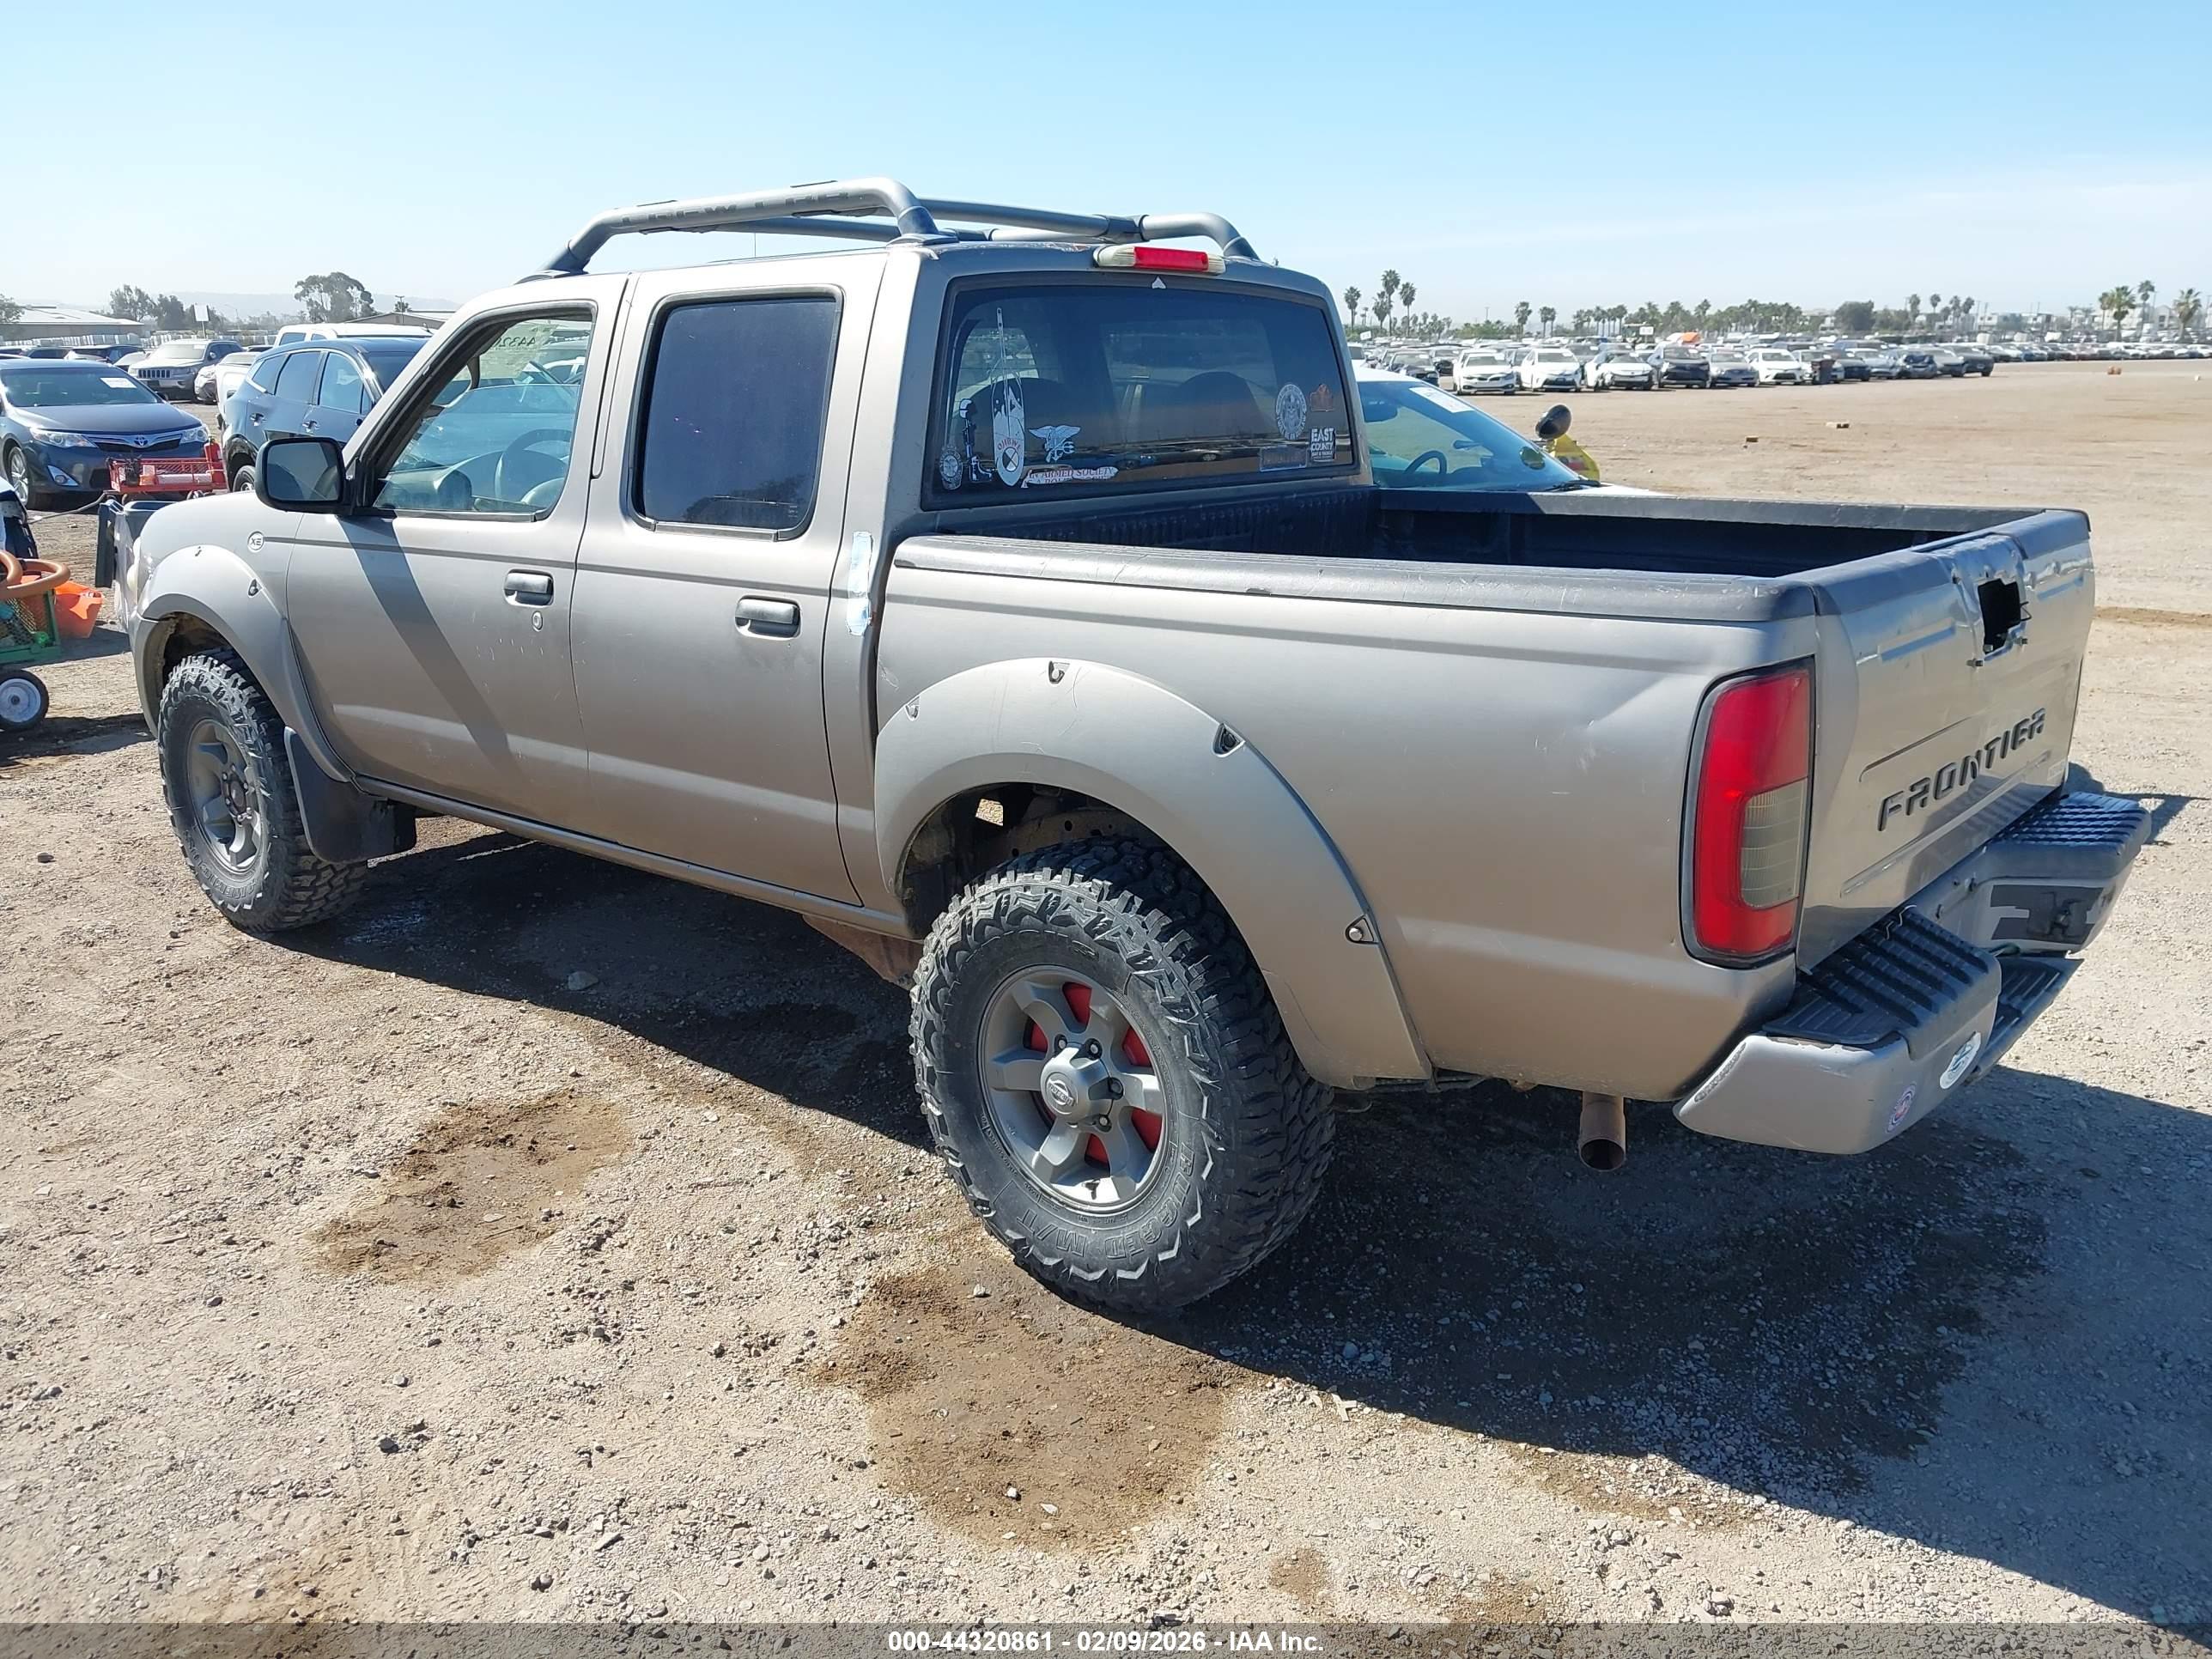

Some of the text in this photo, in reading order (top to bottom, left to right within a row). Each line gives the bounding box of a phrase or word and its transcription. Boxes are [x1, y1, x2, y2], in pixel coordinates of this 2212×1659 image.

[1311, 428, 1334, 441] EAST
[1311, 441, 1334, 451] COUNTY
[1076, 466, 1115, 477] SOCIETY
[250, 538, 262, 546] XE
[1878, 708, 2046, 831] FRONTIER
[1105, 1141, 1195, 1260] RUGGED
[1016, 1208, 1088, 1258] M/T
